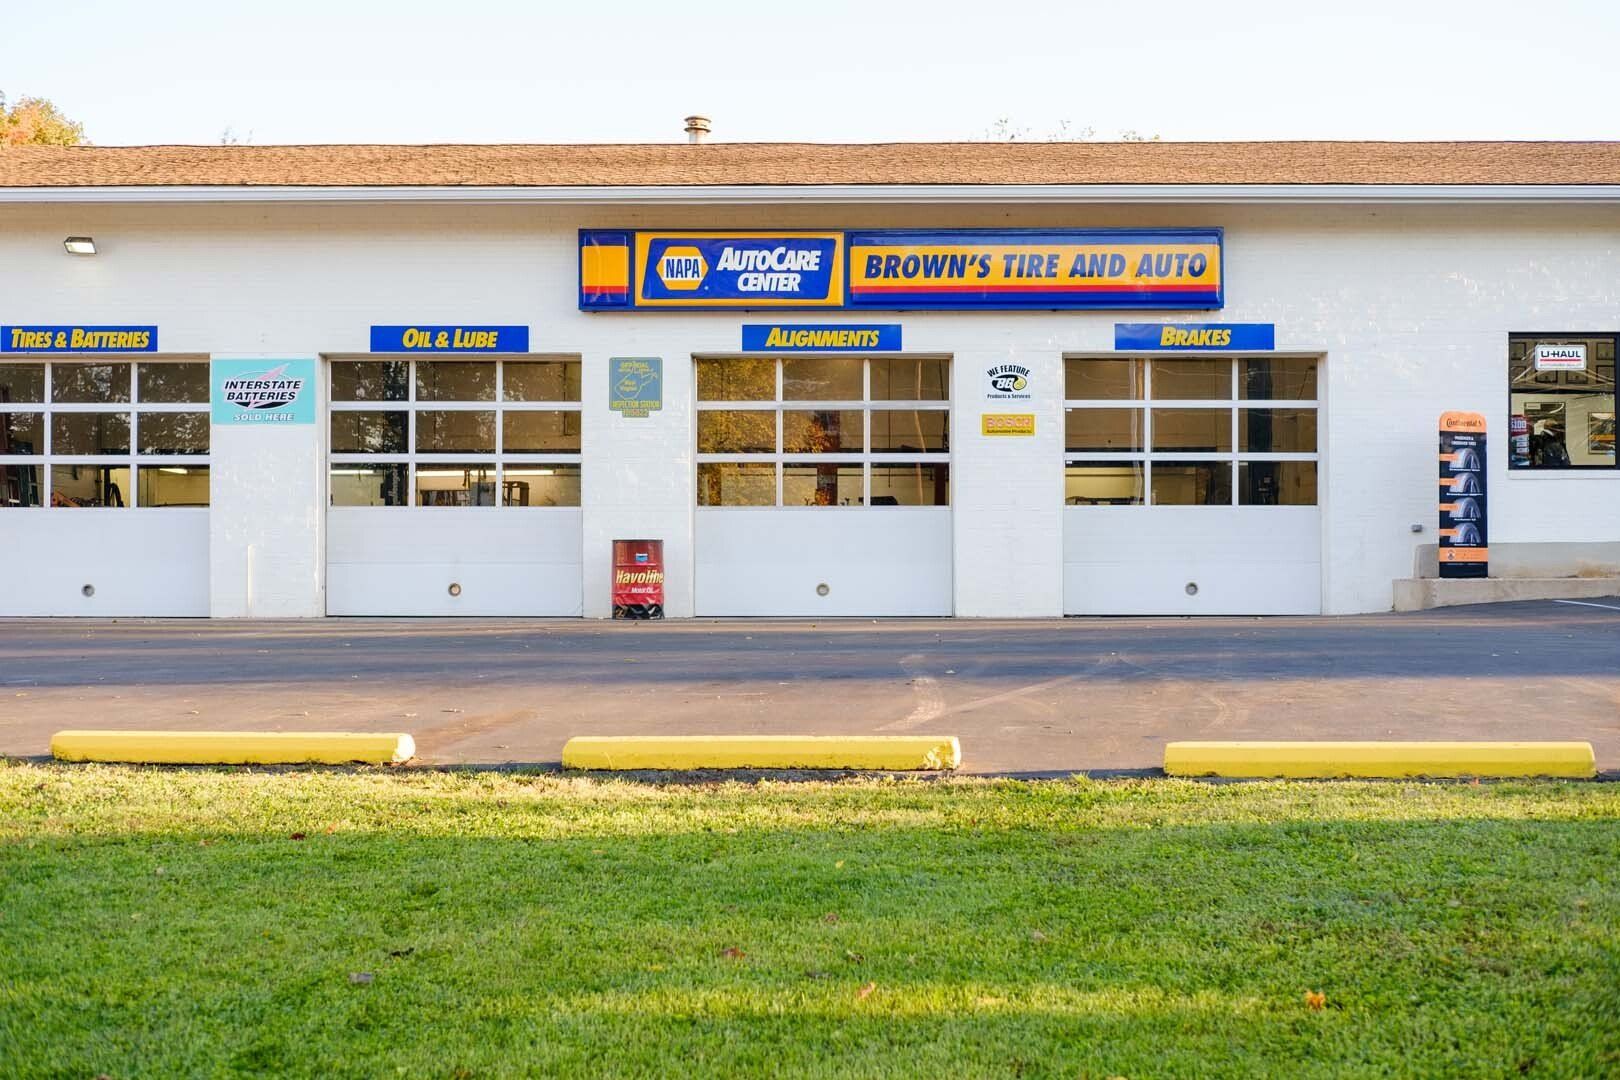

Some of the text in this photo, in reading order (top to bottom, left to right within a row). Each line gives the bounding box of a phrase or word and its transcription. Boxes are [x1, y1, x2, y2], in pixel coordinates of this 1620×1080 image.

[666, 258, 701, 279] NAPA
[864, 253, 1207, 278] BROWN'S TIRE AND AUTO
[737, 273, 802, 292] CENTER
[11, 328, 149, 348] TIRES & BATTERIES
[402, 328, 498, 348] OIL & LUBE
[765, 327, 880, 347] ALIGNMENTS
[1160, 326, 1232, 346] BRAKES
[1540, 350, 1582, 358] U-HAUL
[986, 364, 1031, 378] WE FEATURE
[224, 380, 302, 390] INTERSTATE
[226, 391, 296, 401] BATTERIES
[233, 413, 294, 421] SOLD HERE
[986, 416, 1032, 428] BOSCH
[615, 568, 664, 584] Havoline
